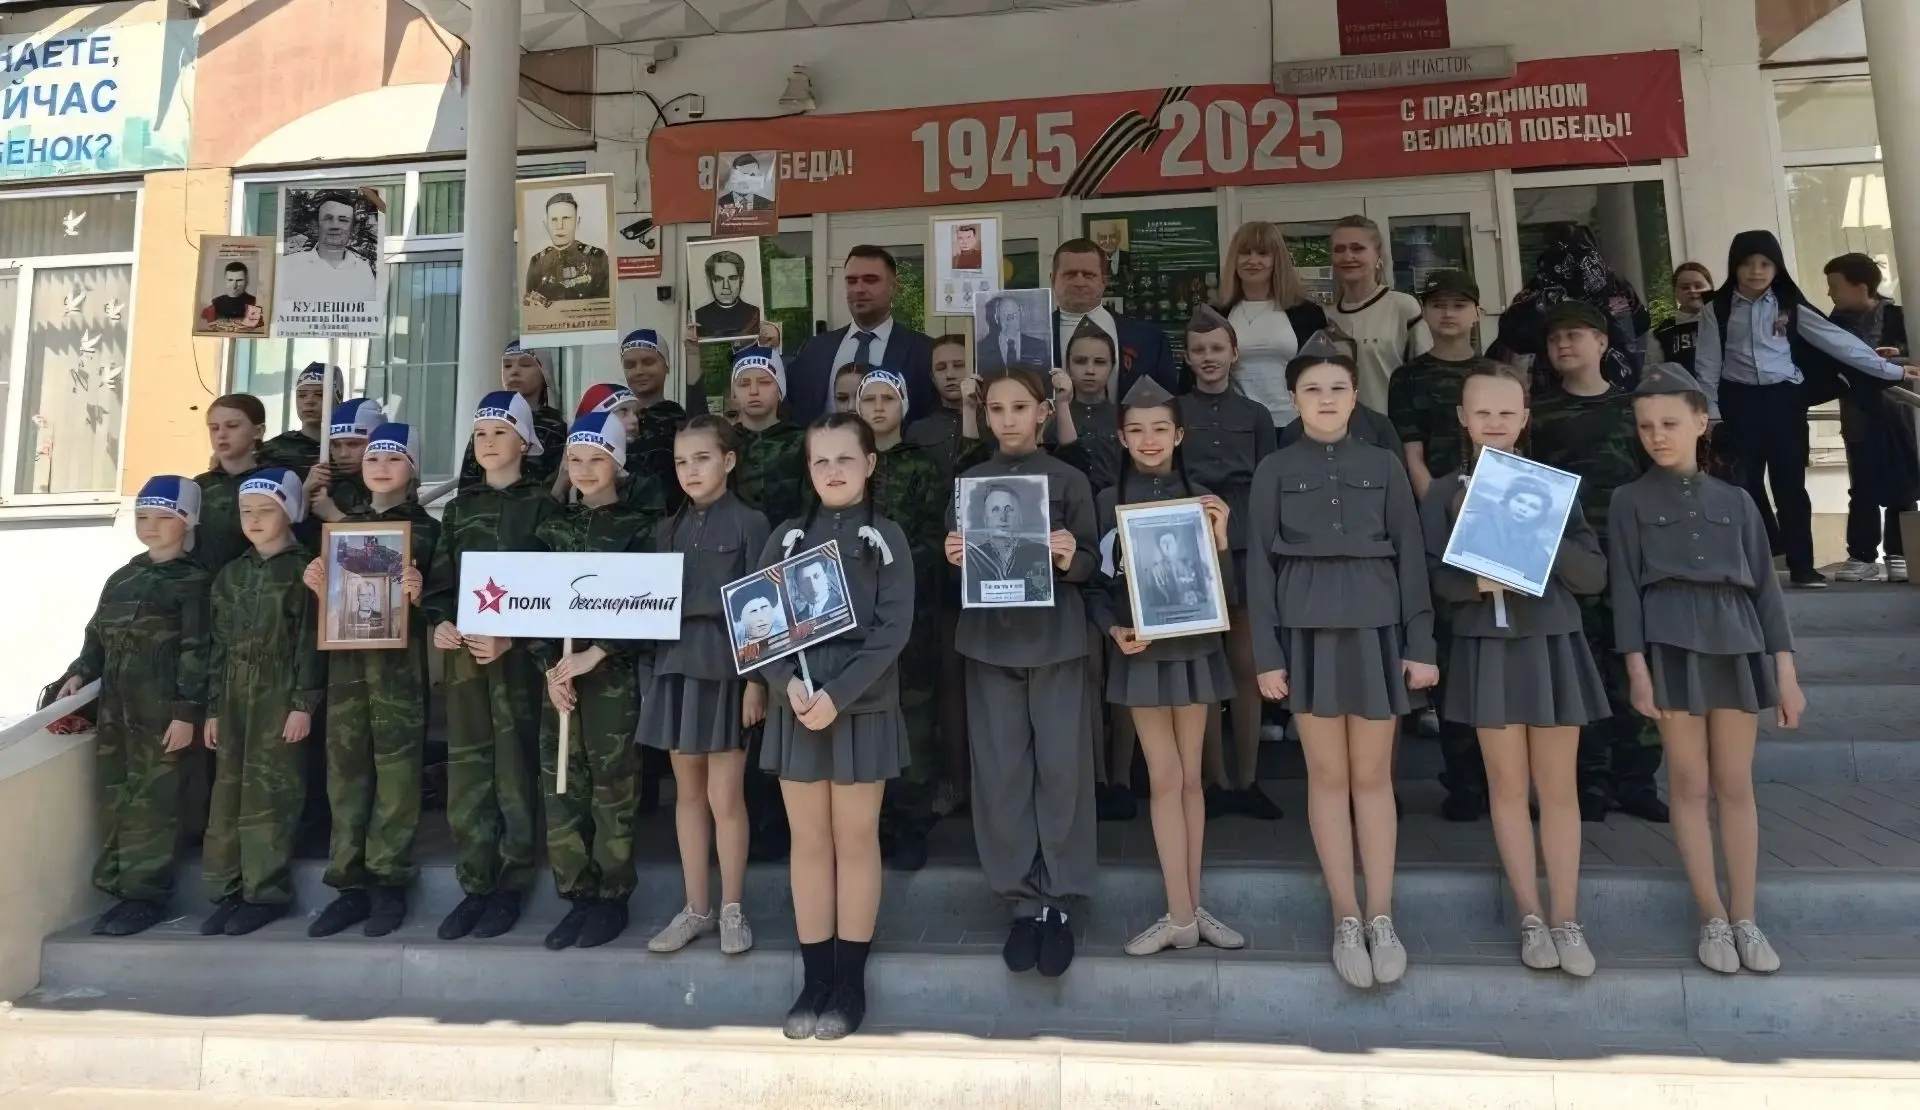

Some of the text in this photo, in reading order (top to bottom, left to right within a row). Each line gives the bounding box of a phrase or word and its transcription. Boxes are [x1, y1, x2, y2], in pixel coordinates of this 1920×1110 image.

[2, 78, 117, 119] ЙЧАС
[1401, 83, 1588, 121] С ПРАЗДНИКОМ
[0, 133, 112, 166] ЕНОК?
[912, 97, 1343, 193] 1945 2025
[1403, 112, 1632, 152] ВЕЛИКОЙ ПОБЕДЫ!
[780, 150, 853, 182] БЕДА!
[293, 301, 365, 313] КУЛЕШОВ
[508, 597, 551, 610] ПОЛК
